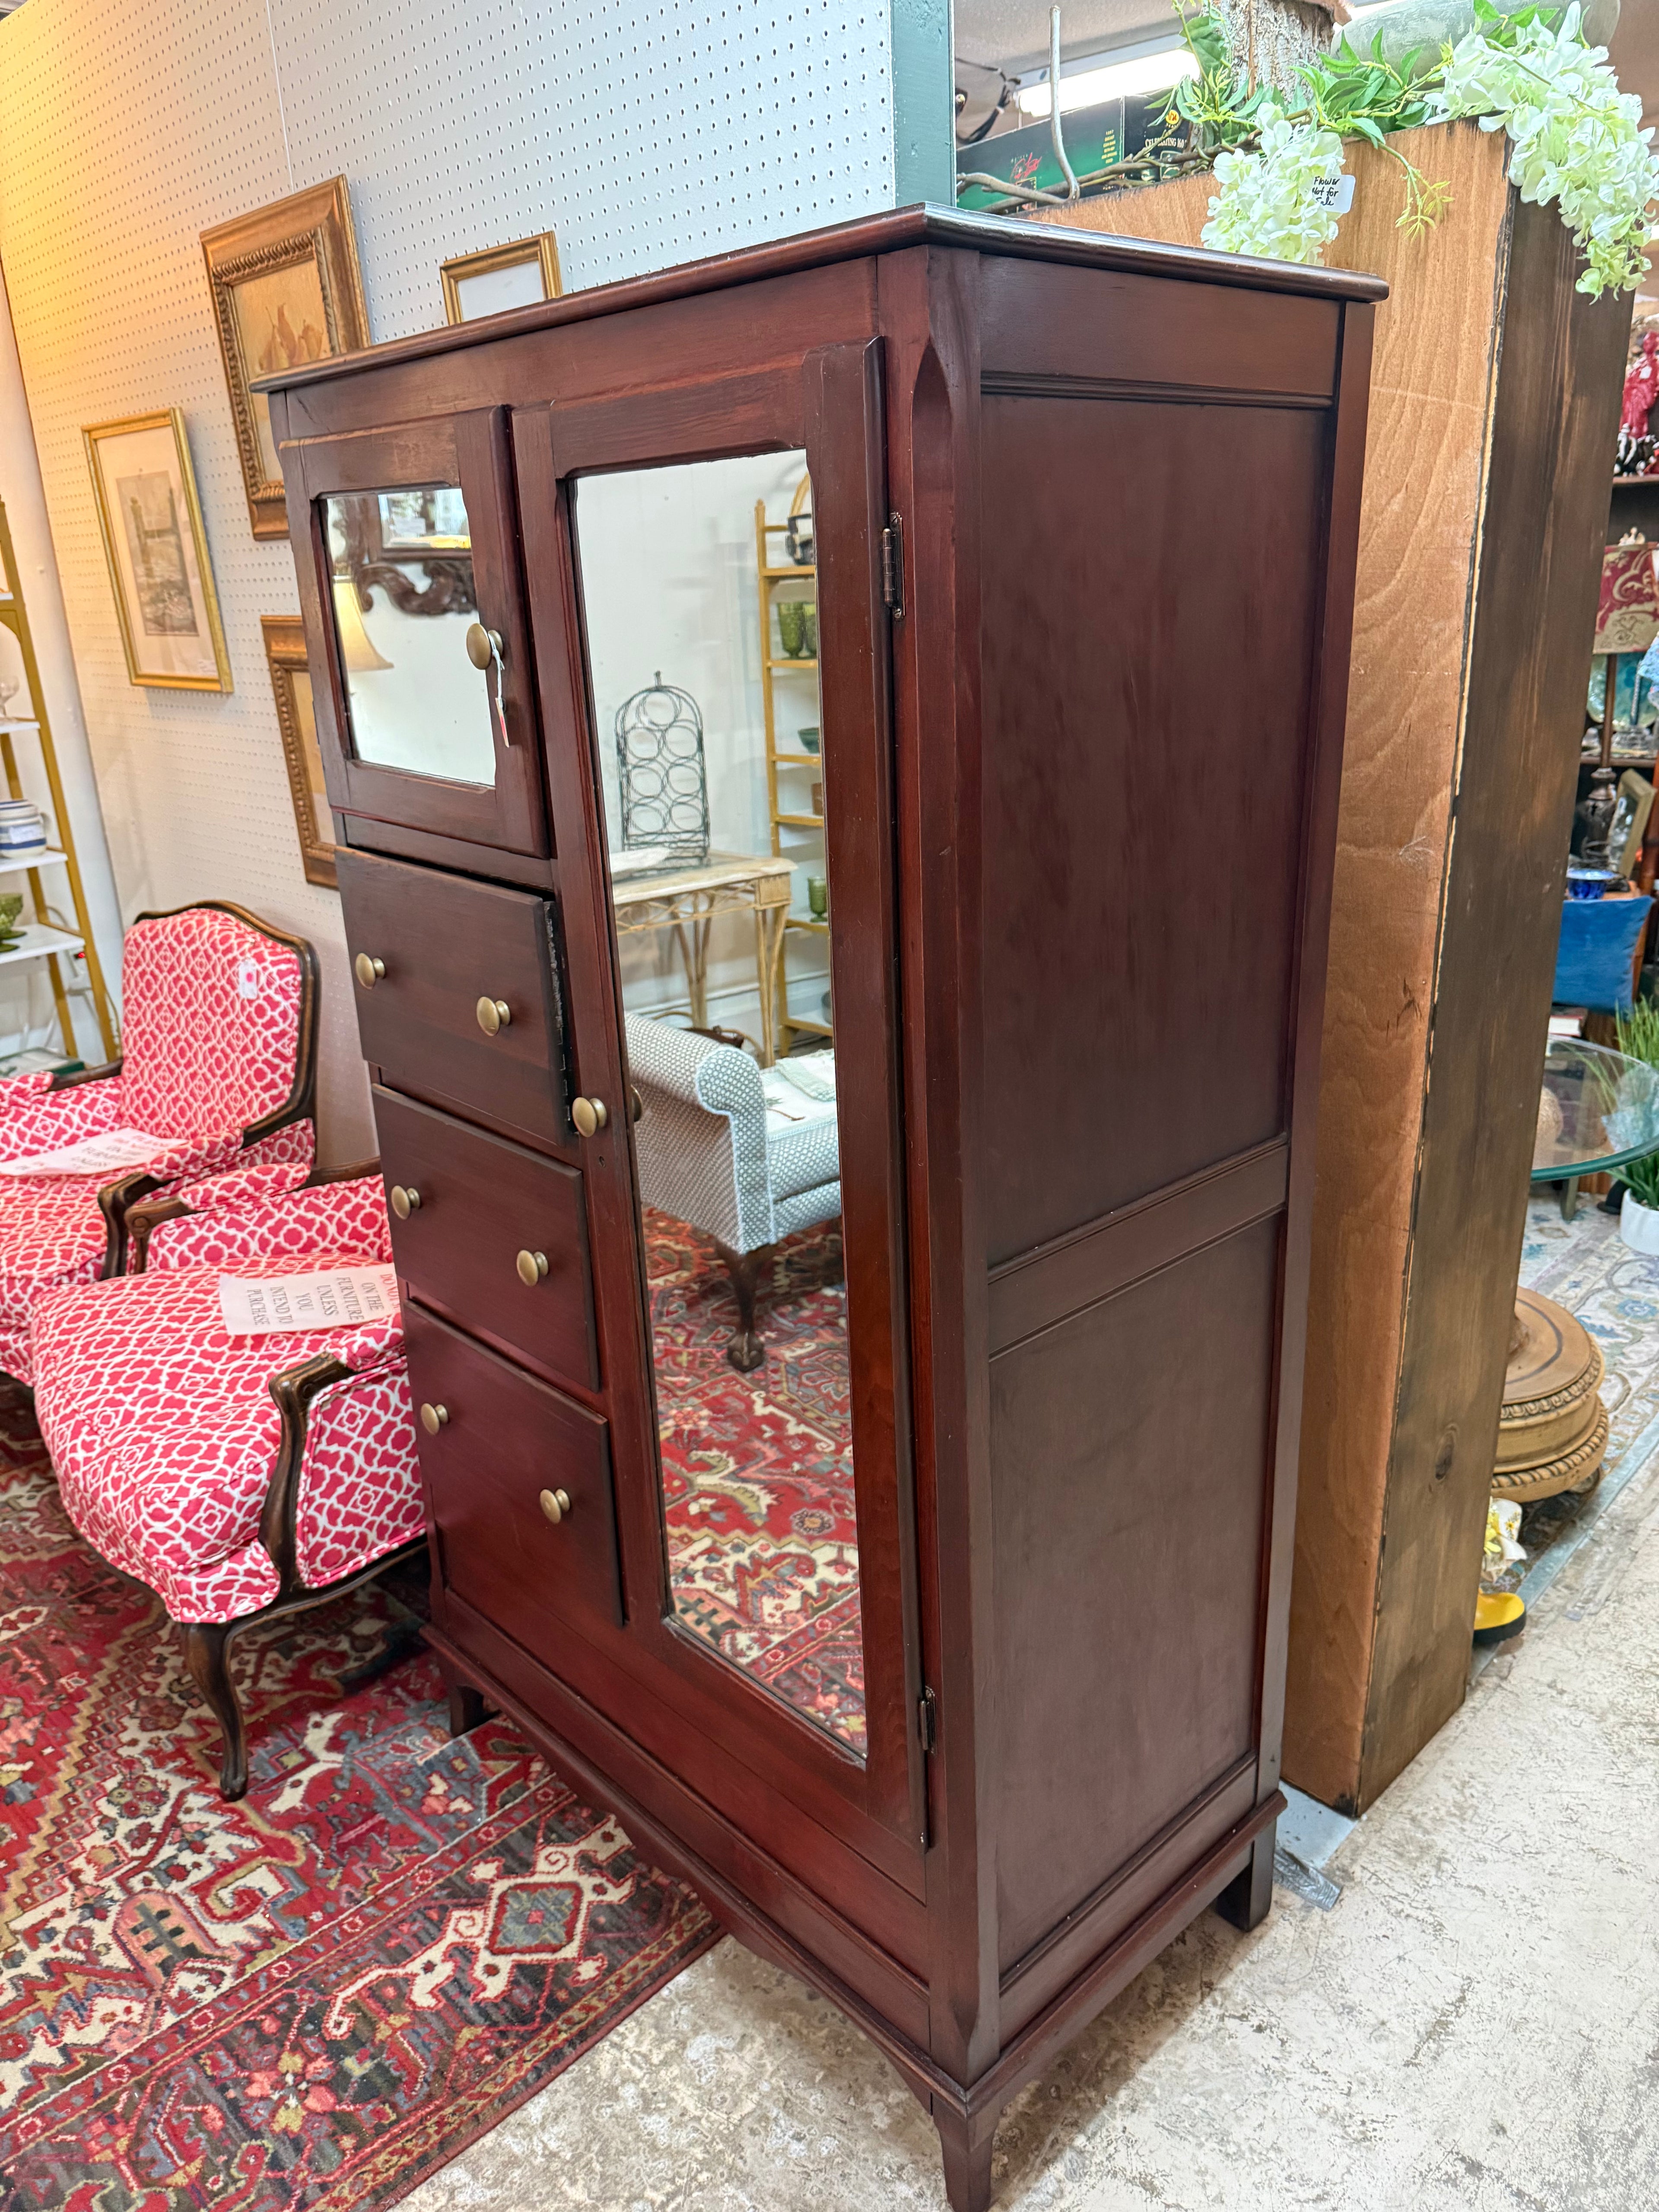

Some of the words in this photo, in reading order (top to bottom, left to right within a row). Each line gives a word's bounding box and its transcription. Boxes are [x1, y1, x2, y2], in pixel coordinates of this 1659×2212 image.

[361, 1282, 378, 1294] ON
[380, 1274, 394, 1285] DO
[247, 1289, 270, 1325] PURCHASE
[270, 1286, 291, 1314] INTEND
[296, 1293, 315, 1311] YOU
[316, 1285, 339, 1316] UNLESS
[336, 1277, 365, 1321] FURNITURE
[366, 1295, 385, 1311] THE
[277, 1314, 294, 1324] TO
